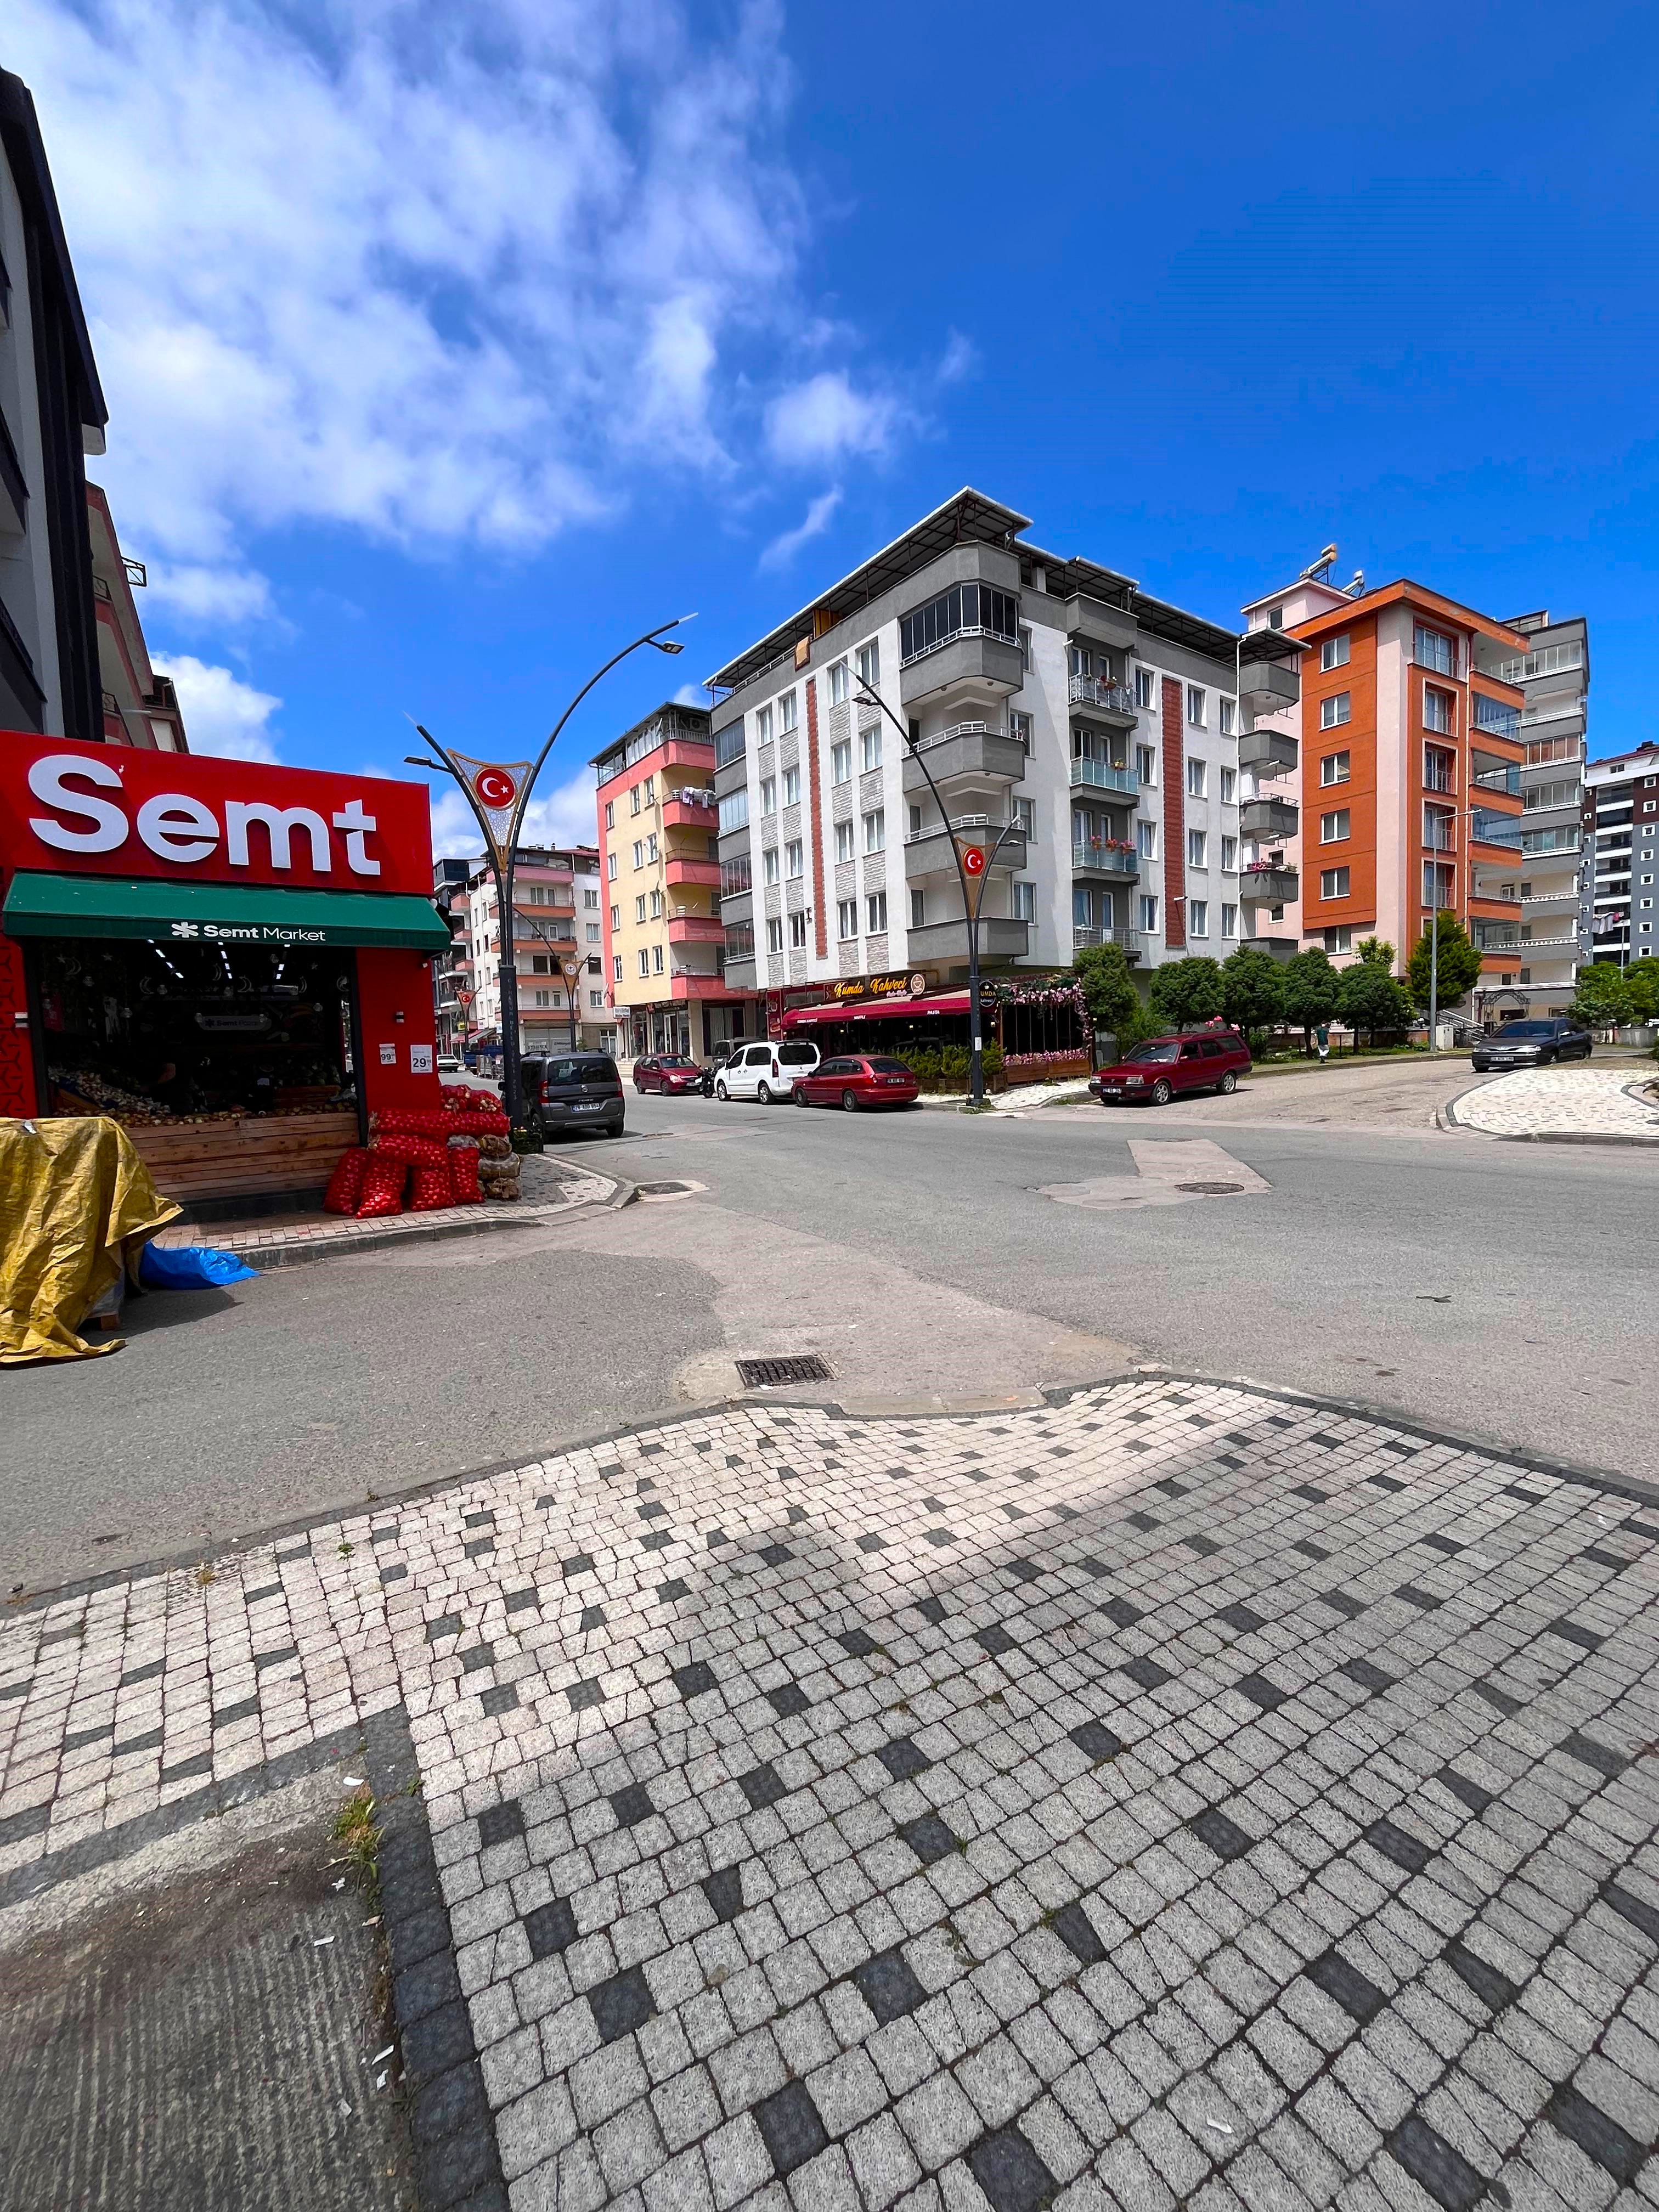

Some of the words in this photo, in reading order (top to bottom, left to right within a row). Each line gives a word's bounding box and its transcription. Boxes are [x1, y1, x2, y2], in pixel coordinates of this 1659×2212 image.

[28, 754, 381, 876] Semt
[204, 925, 259, 939] Semt
[263, 927, 325, 941] Market
[834, 981, 865, 998] Kumda
[413, 1058, 427, 1068] 29
